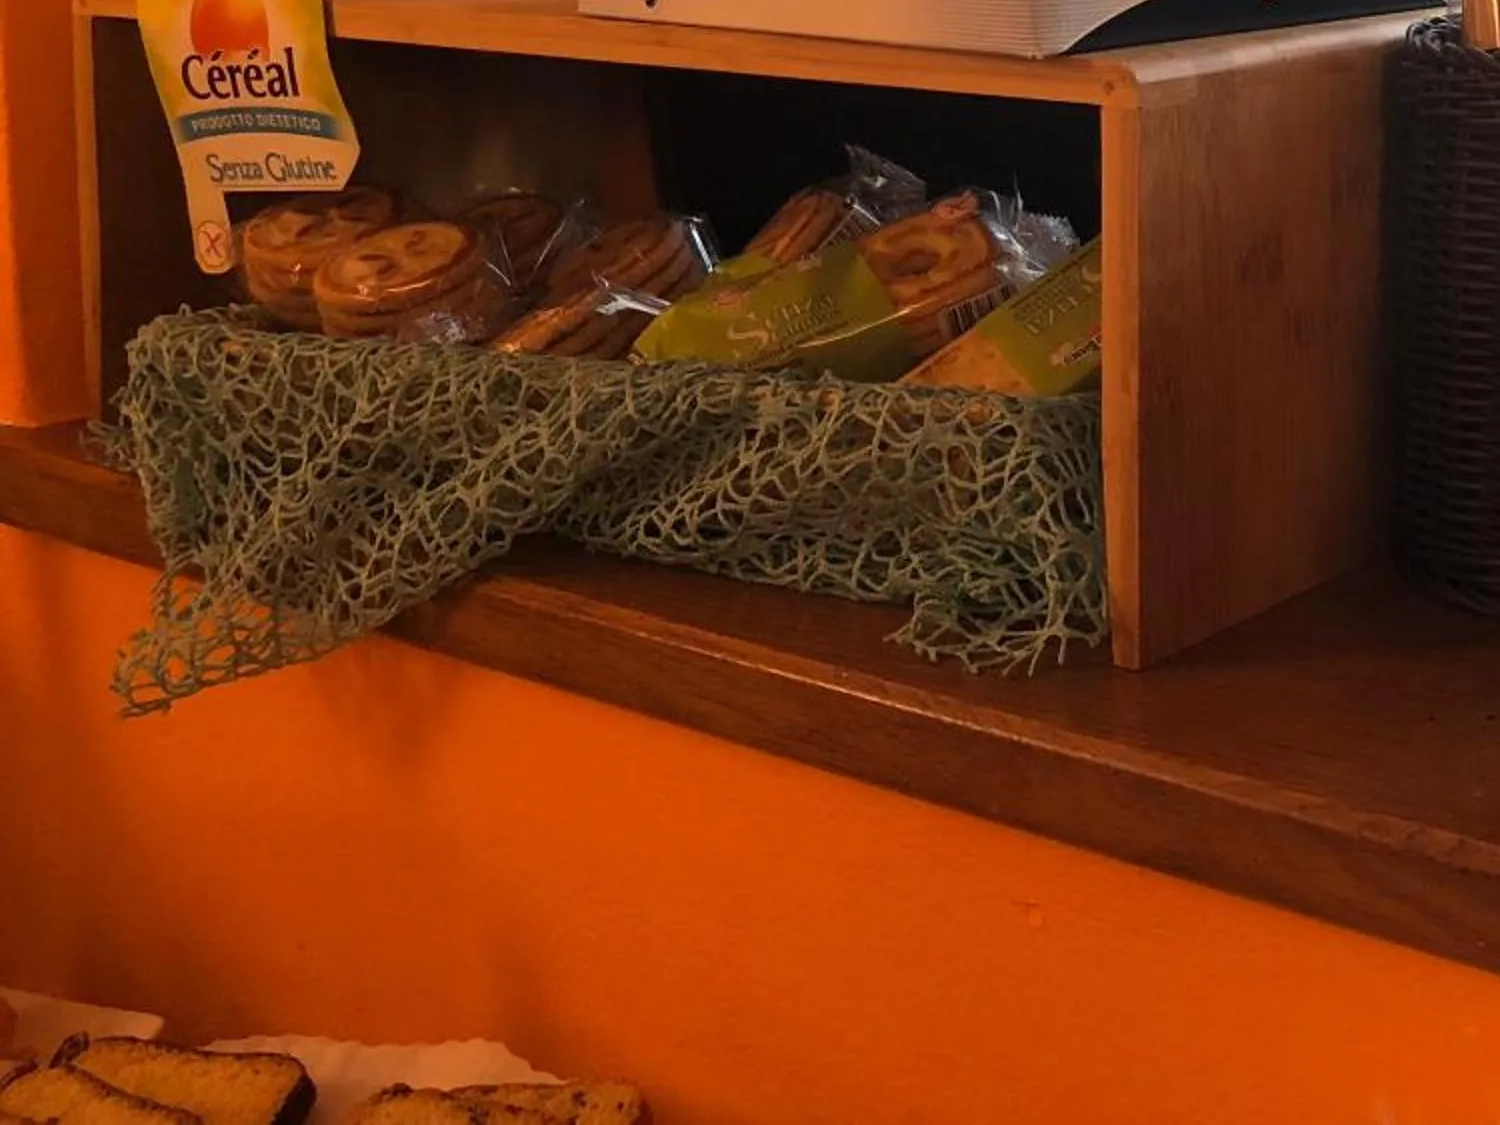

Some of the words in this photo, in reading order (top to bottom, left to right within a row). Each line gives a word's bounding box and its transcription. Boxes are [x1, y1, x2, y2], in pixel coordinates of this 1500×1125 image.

[181, 47, 301, 100] Céréal
[192, 113, 254, 132] PRODOTTO
[255, 113, 321, 132] DIETETICO
[206, 153, 264, 183] Senza
[265, 152, 337, 183] Glutine
